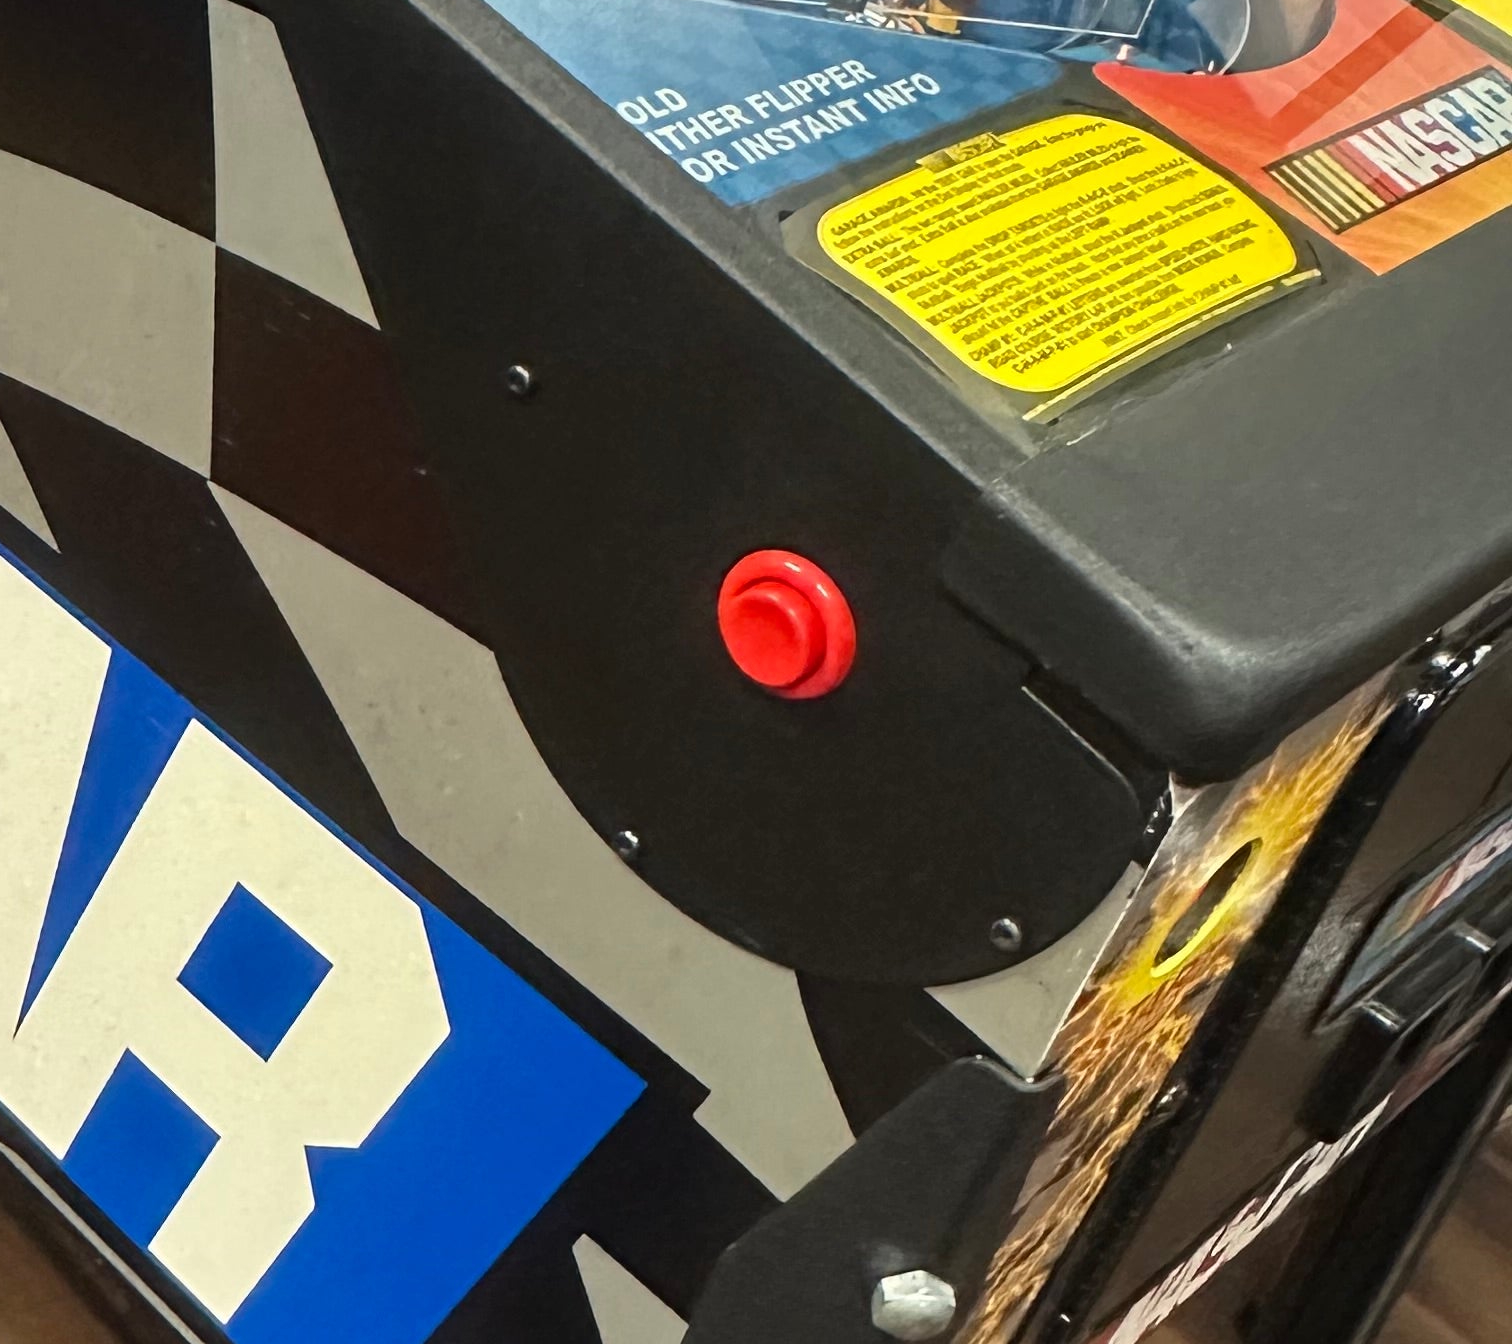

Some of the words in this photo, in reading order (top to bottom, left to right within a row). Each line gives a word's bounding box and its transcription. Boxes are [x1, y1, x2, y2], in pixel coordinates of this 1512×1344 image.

[681, 148, 740, 183] OR
[732, 98, 868, 164] INSTANT
[863, 72, 941, 114] INFO
[744, 59, 877, 119] FLIPPER
